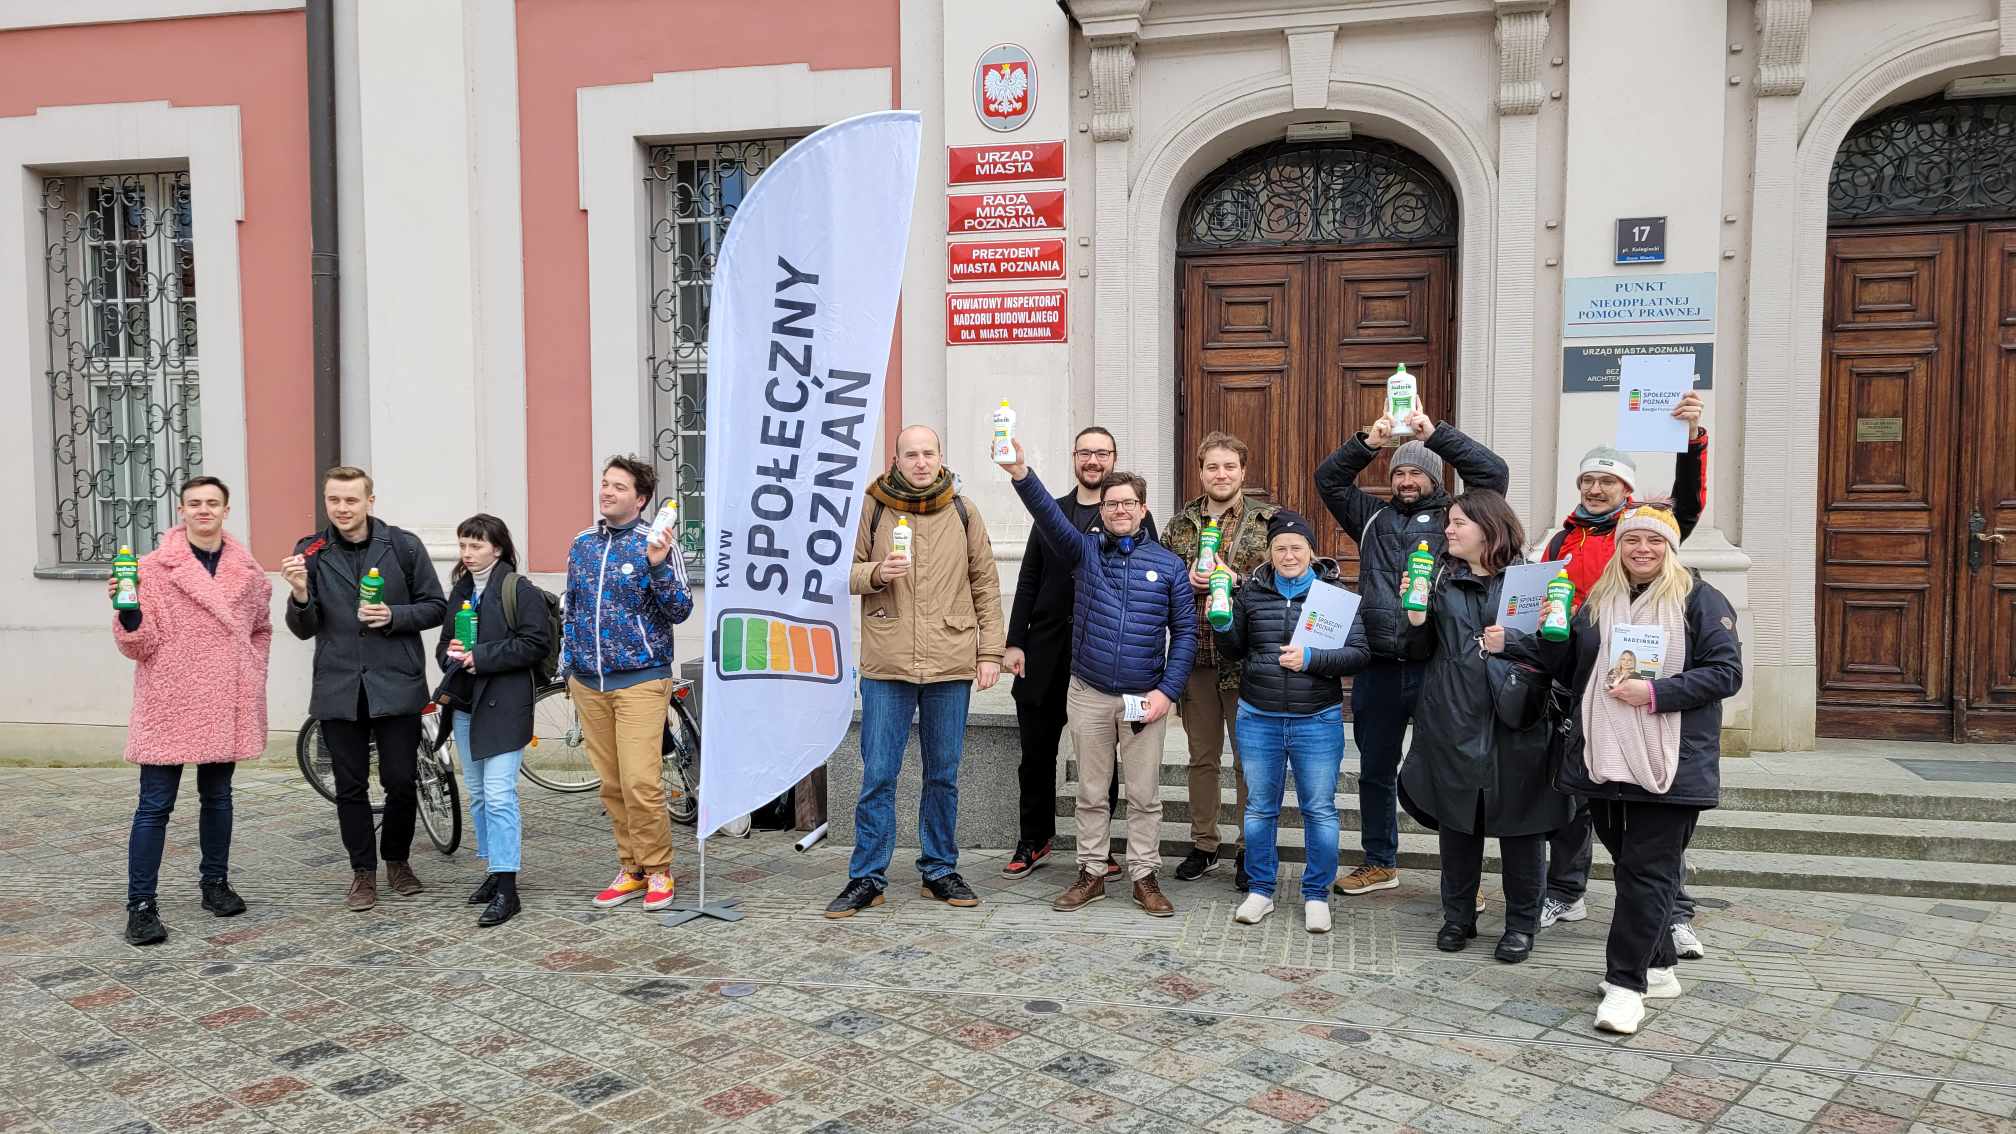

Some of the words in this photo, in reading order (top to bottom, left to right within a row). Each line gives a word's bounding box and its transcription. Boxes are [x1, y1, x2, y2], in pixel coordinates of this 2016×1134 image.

[976, 150, 1033, 165] URZĄD
[975, 163, 1034, 176] MIASTA
[983, 194, 1028, 206] RADA
[976, 205, 1034, 218] MIASTA
[964, 217, 1047, 230] POZNANIA
[1632, 226, 1650, 242] 17
[972, 247, 1040, 259] PREZYDENT
[953, 262, 996, 275] MIASTA
[1000, 260, 1060, 273] POZNANIA
[1615, 281, 1667, 293] PUNKT
[951, 296, 1003, 310] POWIATOWY
[1004, 295, 1061, 308] INSPEKTORAT
[1590, 297, 1689, 308] NIEODPŁATNEJ
[953, 312, 992, 325] NADZORU
[994, 311, 1059, 324] BUDOWLANEGO
[1578, 308, 1635, 320] POMOCY
[1639, 307, 1701, 319] PRAWNEJ
[960, 329, 976, 340] DLA
[980, 328, 1009, 339] MIASTA
[1013, 326, 1051, 338] POZNANIA
[1582, 348, 1613, 356] URZĄD
[1614, 347, 1647, 355] MIASTA
[1649, 346, 1695, 354] POZNANIA
[745, 255, 820, 596] SPOŁECZNY
[801, 368, 872, 605] POZNAŃ
[715, 529, 733, 588] KWW
[1650, 653, 1659, 663] 3
